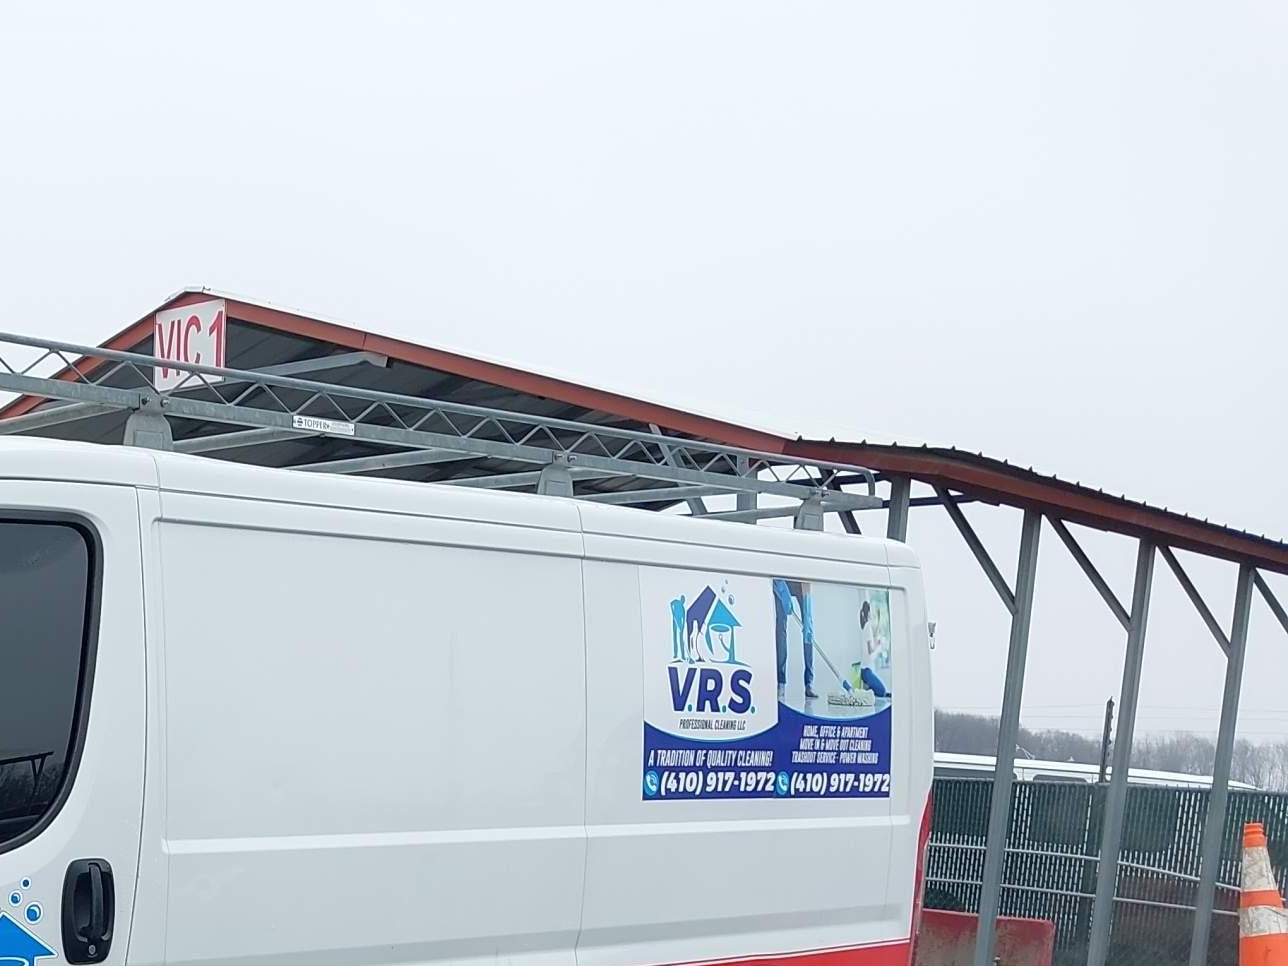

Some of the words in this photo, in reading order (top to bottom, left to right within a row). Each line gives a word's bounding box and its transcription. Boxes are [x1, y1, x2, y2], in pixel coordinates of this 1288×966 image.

[157, 314, 202, 379] VIC
[208, 310, 223, 367] 1
[668, 666, 756, 714] V.R.S.
[679, 718, 713, 730] PROFESSIONAL
[714, 720, 736, 731] CLEANING
[737, 721, 746, 731] LLC
[648, 750, 655, 767] A
[656, 750, 695, 767] TRADITION
[696, 751, 706, 767] OF
[707, 751, 737, 768] QUALITY
[737, 751, 774, 767] CLEANING!
[660, 771, 703, 796] (410)
[705, 771, 776, 792] 917-1972
[790, 772, 827, 796] (410)
[829, 773, 890, 792] 917-1972
